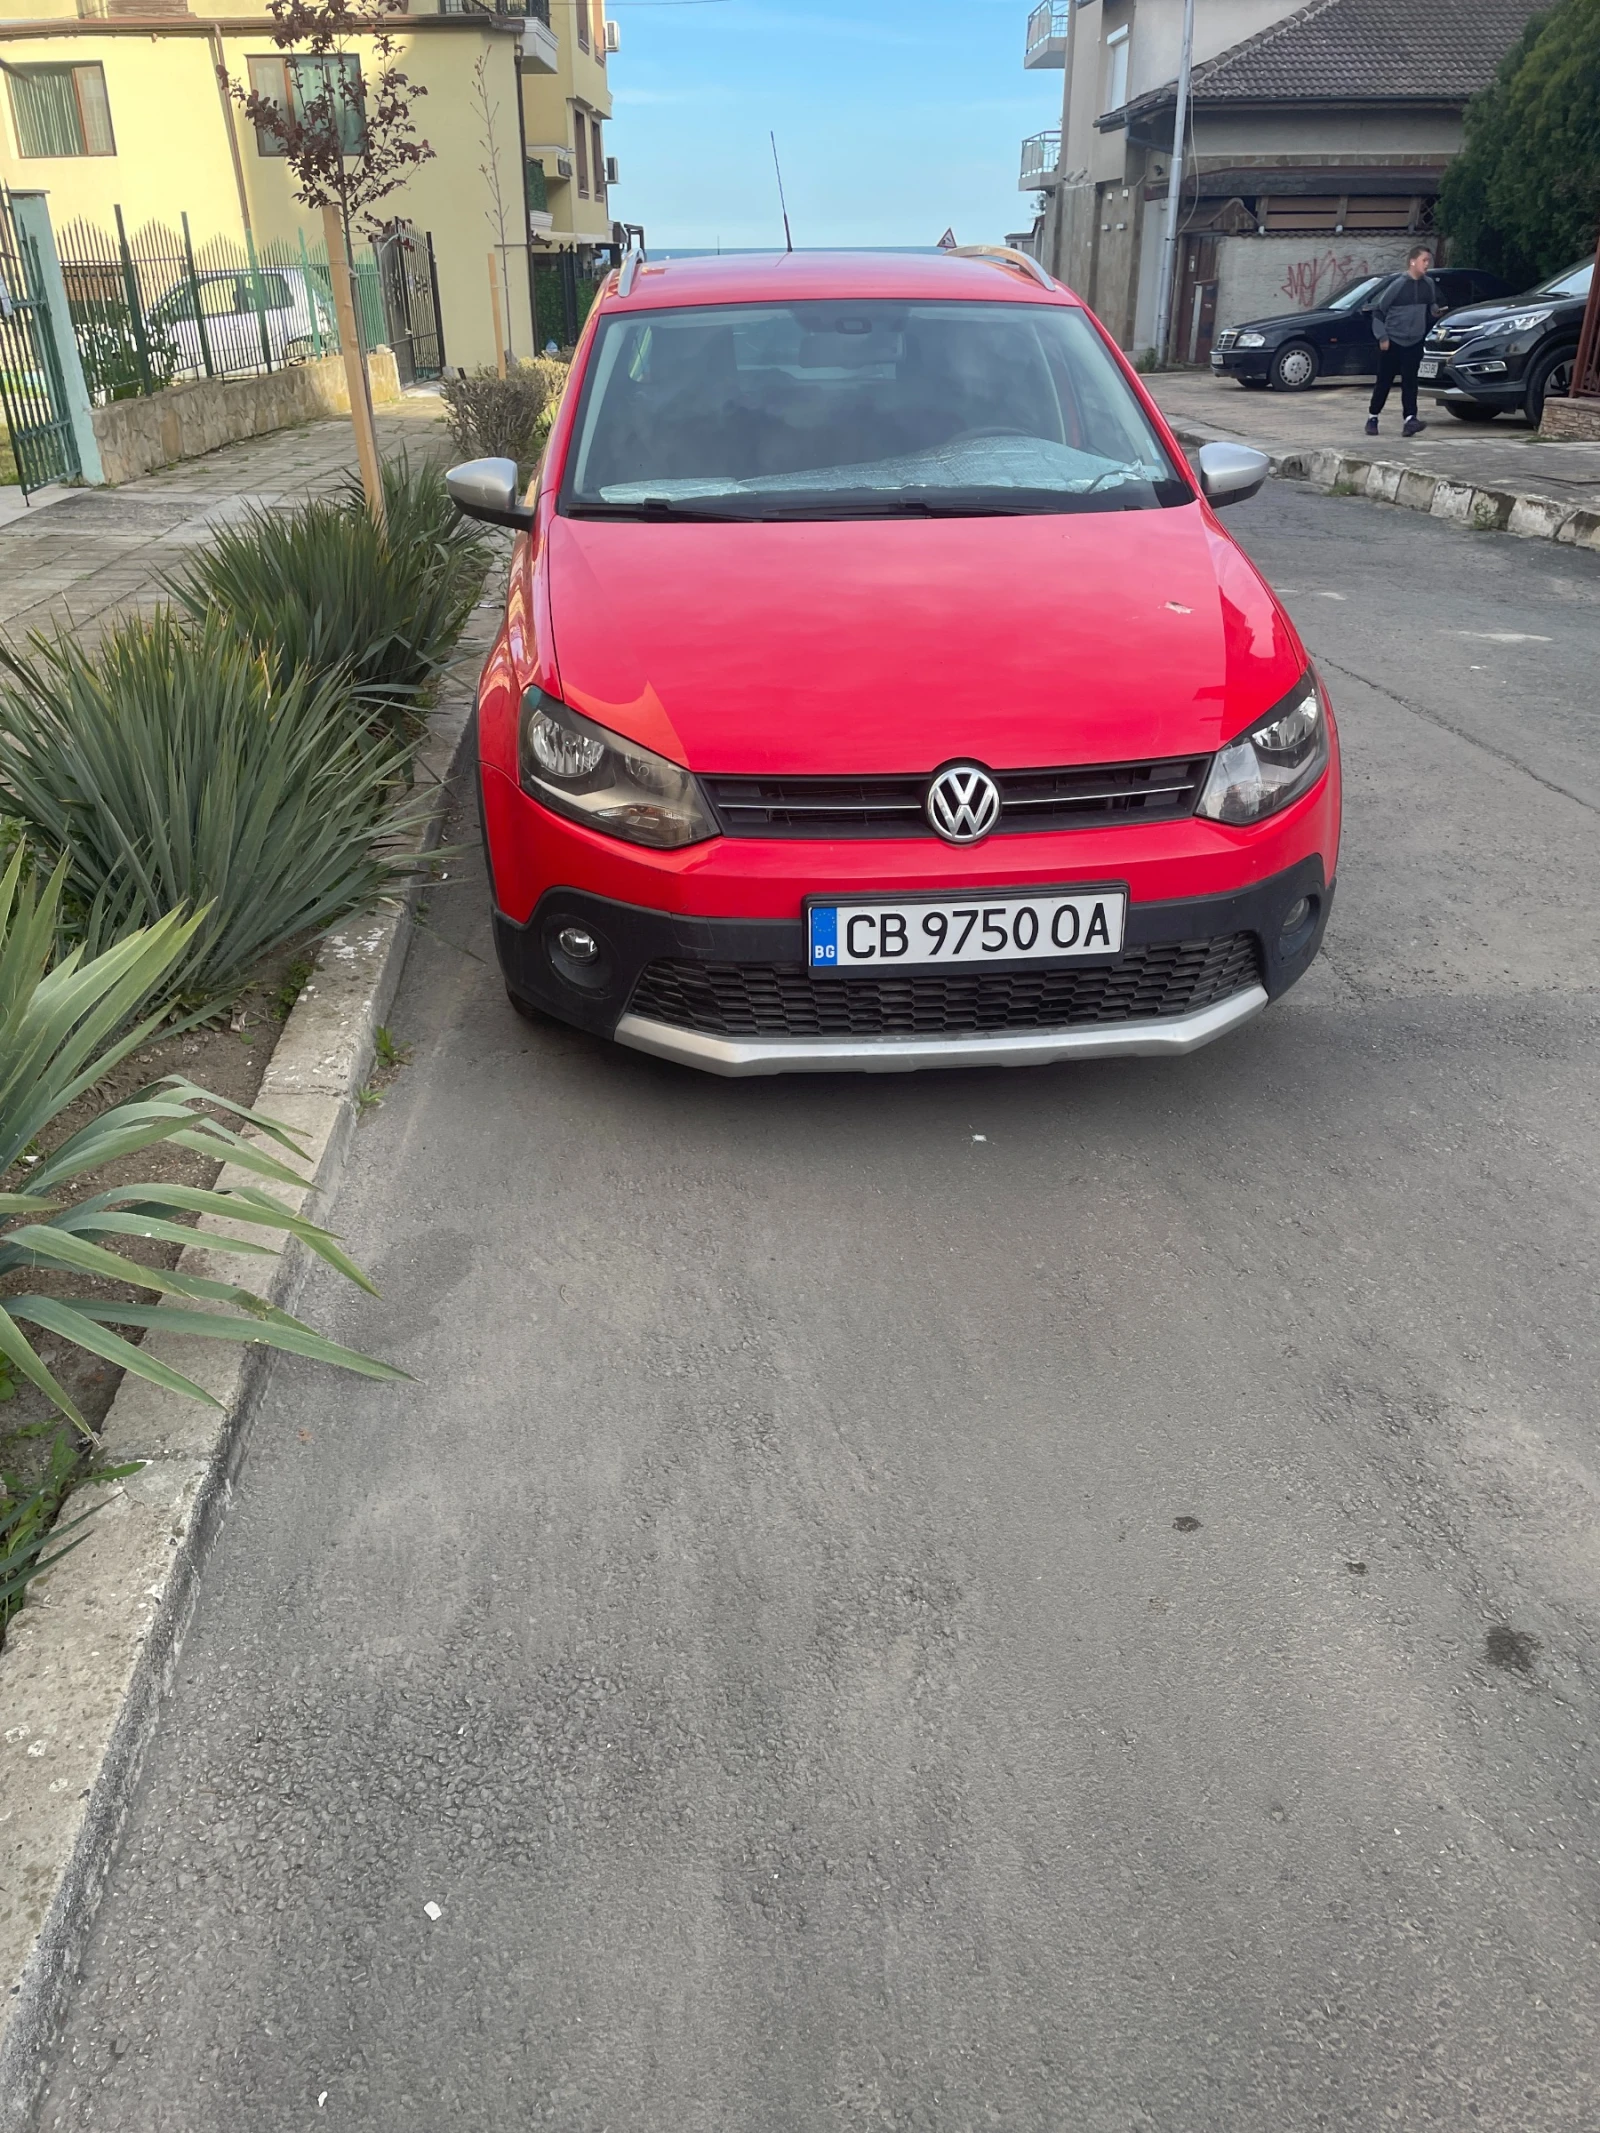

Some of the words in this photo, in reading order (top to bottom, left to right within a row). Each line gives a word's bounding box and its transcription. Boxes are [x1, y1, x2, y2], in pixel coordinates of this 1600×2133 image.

[929, 767, 999, 841] VW
[814, 945, 835, 959] BG
[847, 912, 909, 959] CB
[922, 906, 1039, 956] 9750
[1051, 902, 1110, 949] OA
